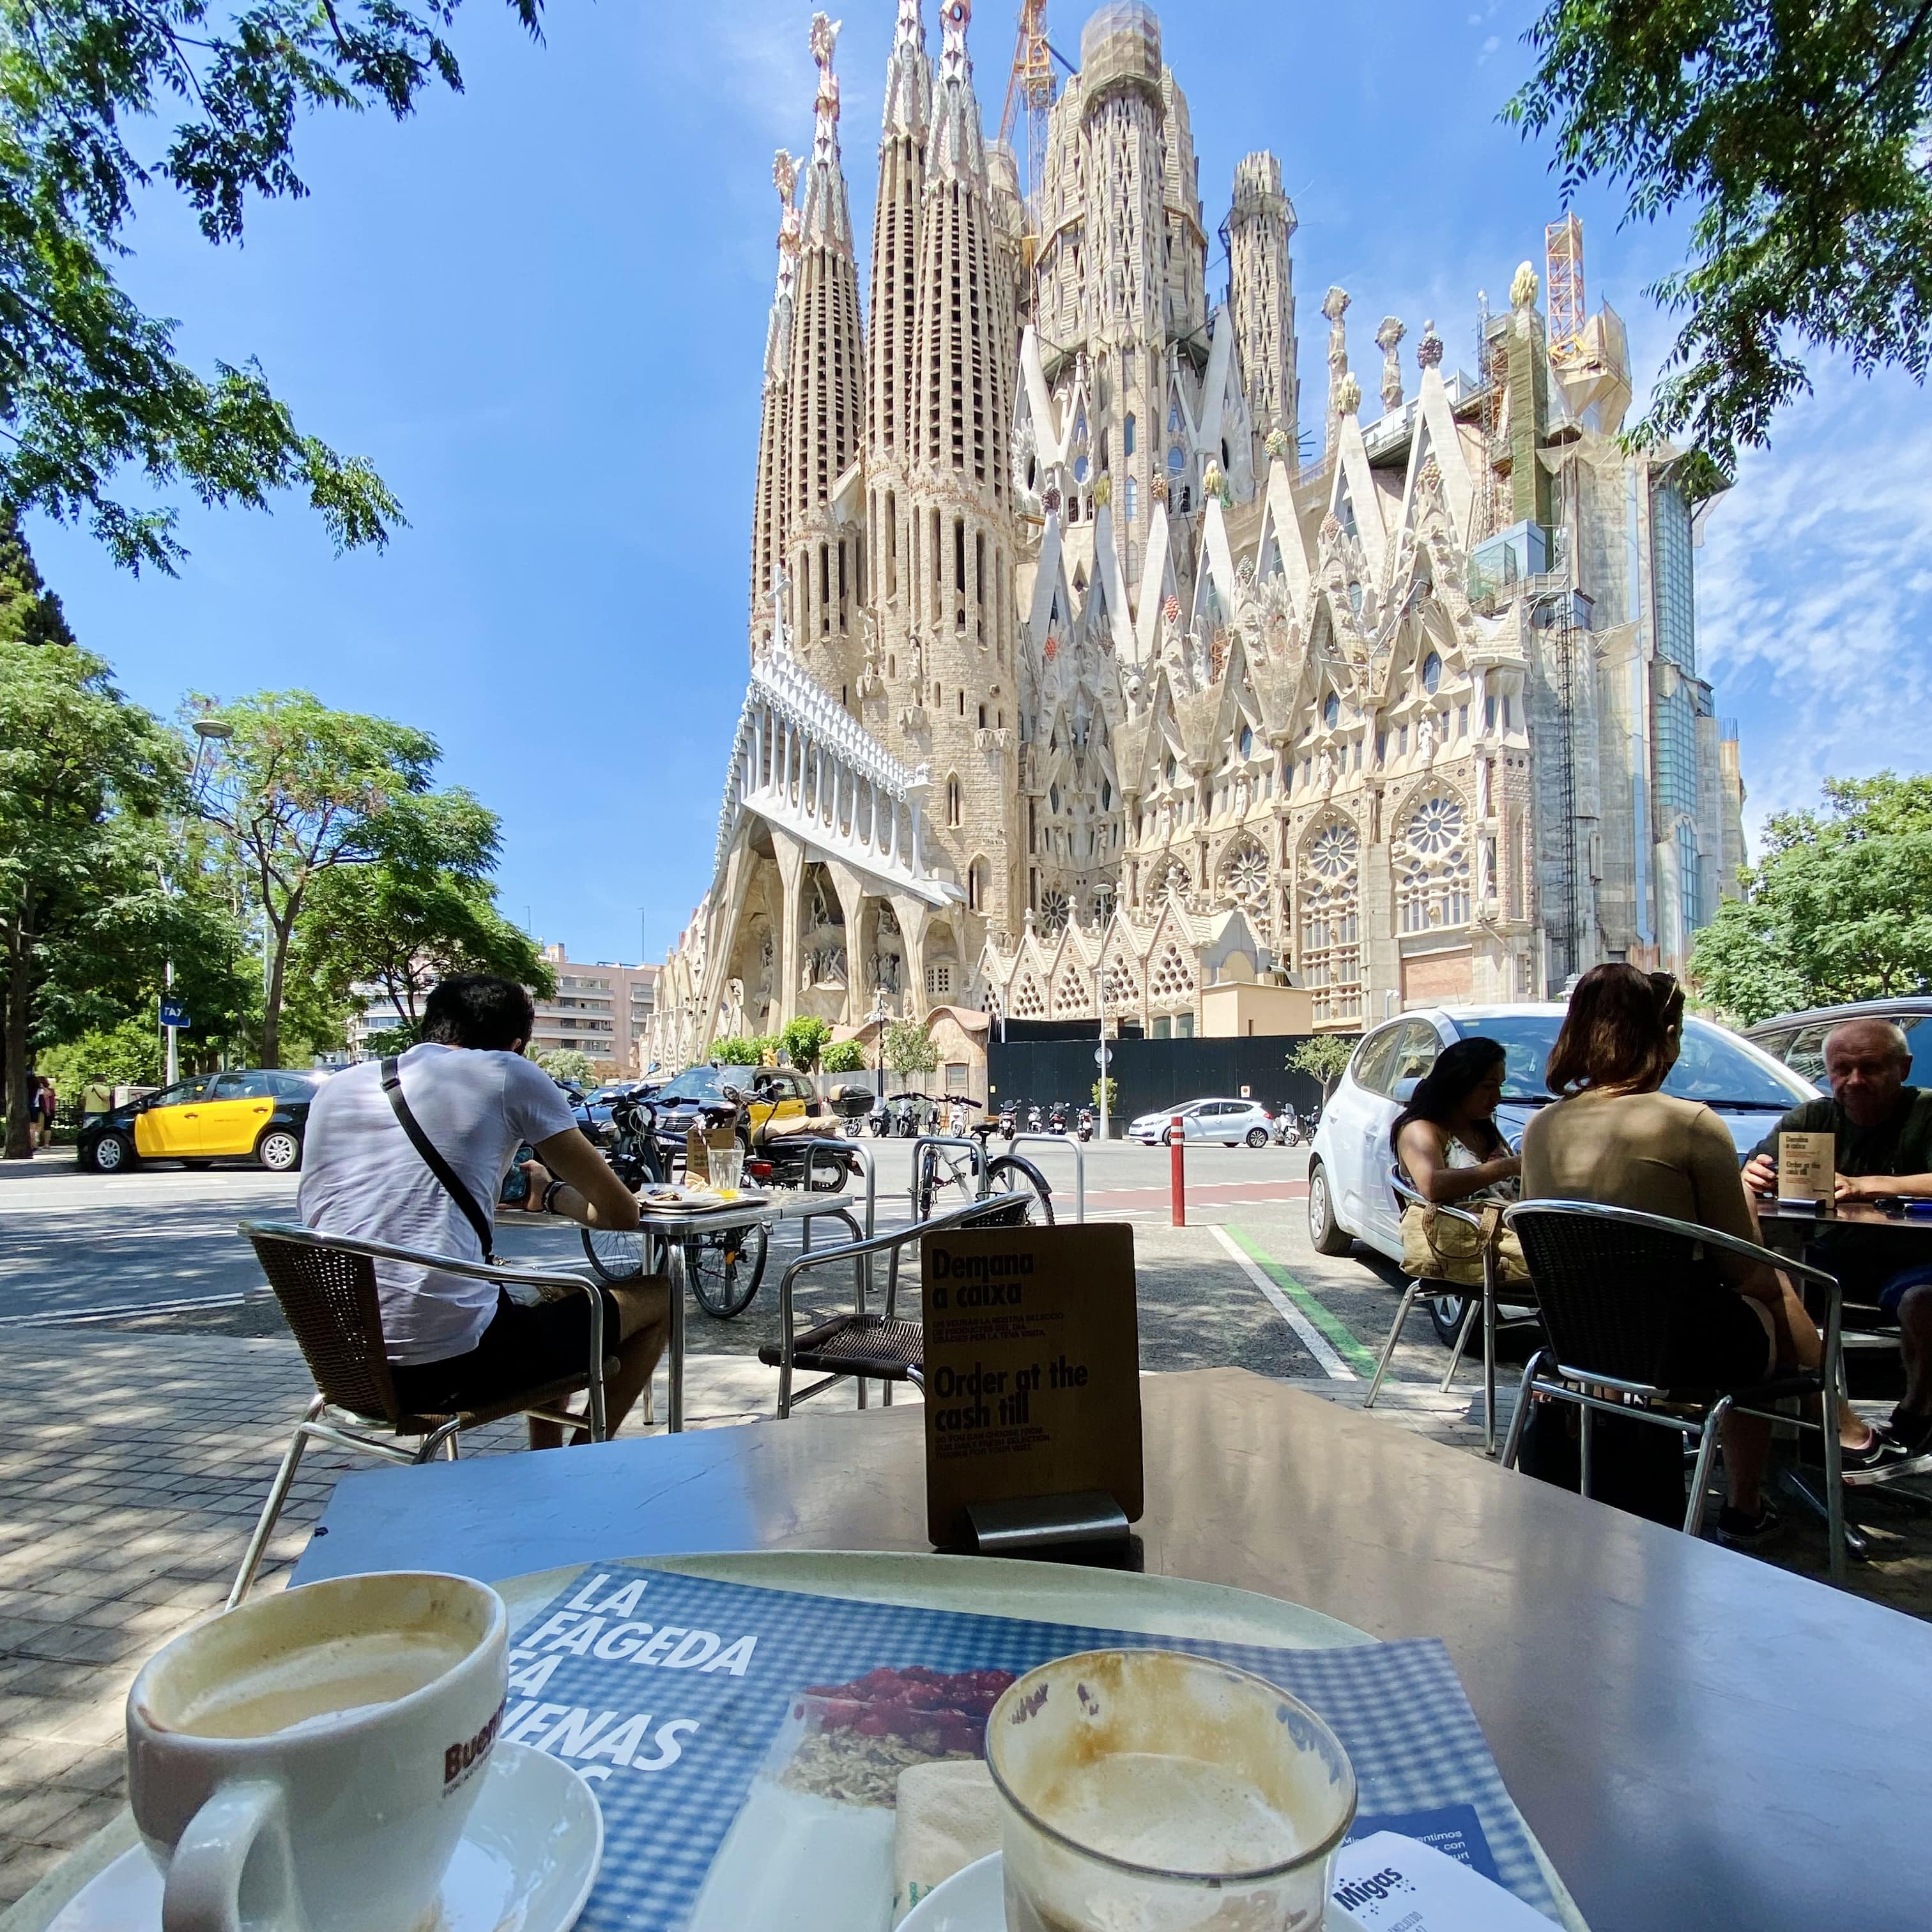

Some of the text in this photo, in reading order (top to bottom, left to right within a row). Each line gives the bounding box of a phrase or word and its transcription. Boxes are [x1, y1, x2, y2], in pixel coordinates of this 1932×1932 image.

[164, 1007, 183, 1017] TAX
[932, 1248, 1034, 1280] Demana
[932, 1279, 1022, 1309] a caixa
[934, 1355, 1088, 1398] Order at the
[935, 1391, 1029, 1432] cash till
[564, 1574, 648, 1618] LA
[519, 1611, 758, 1676] FAGEDA
[1444, 1841, 1466, 1850] con
[1333, 1867, 1402, 1911] Migas
